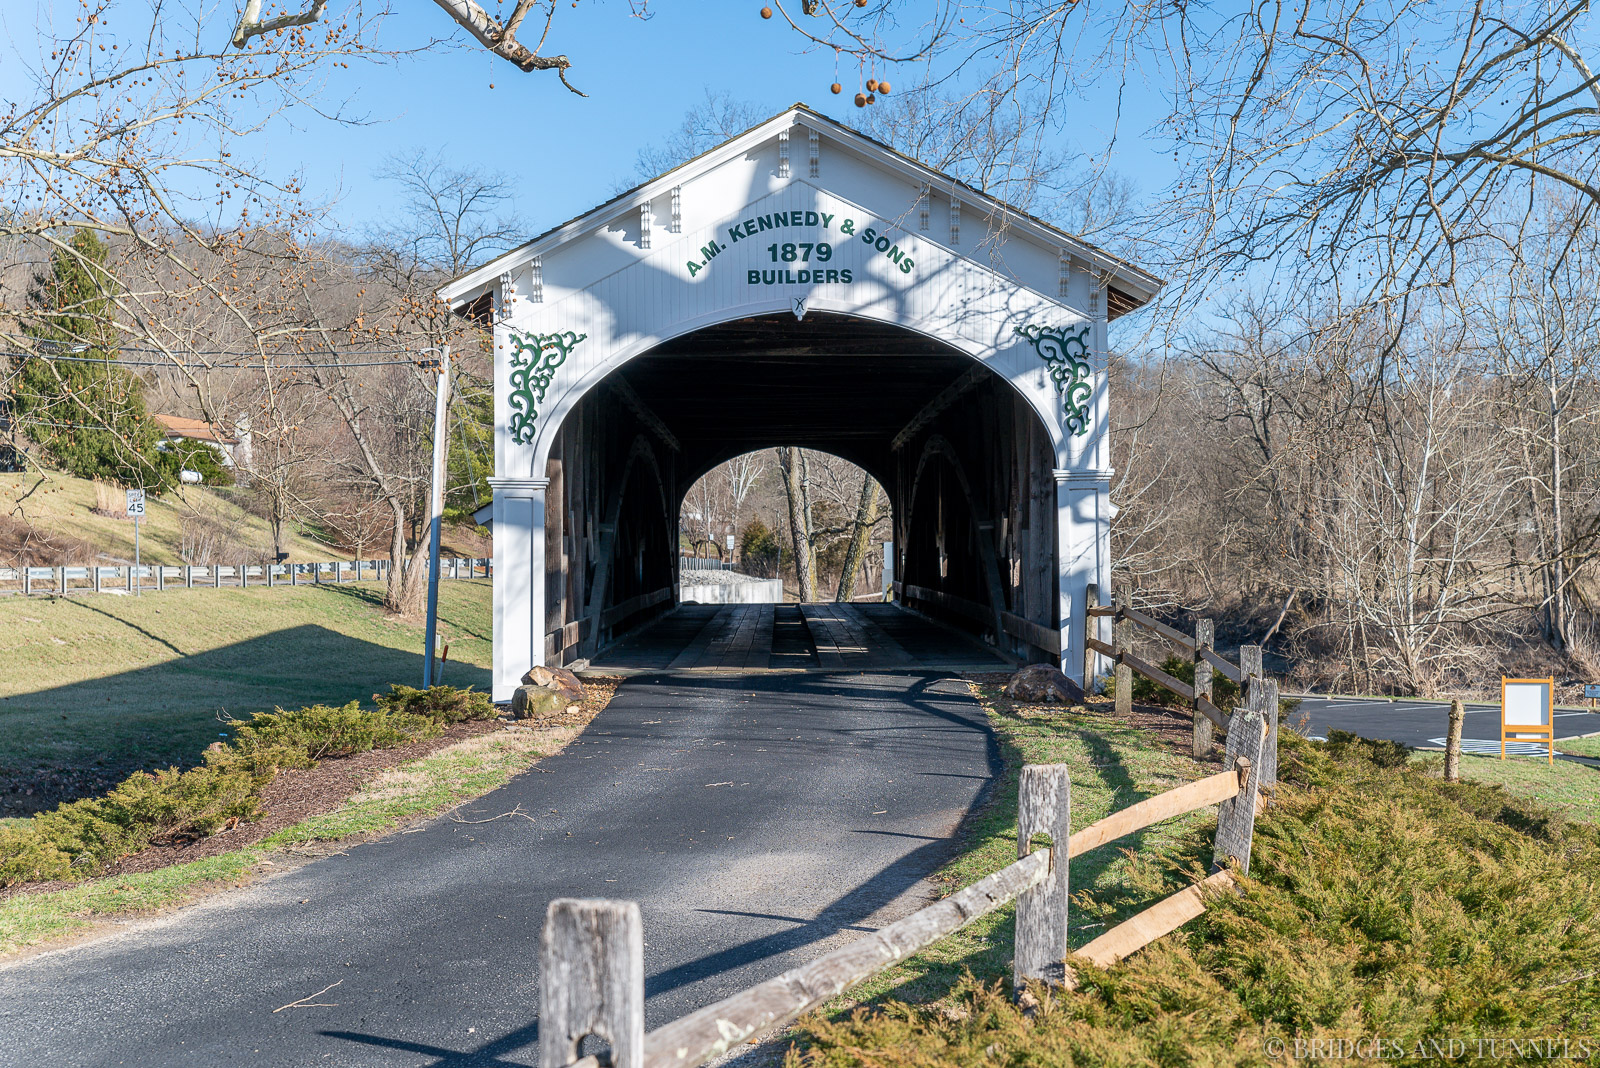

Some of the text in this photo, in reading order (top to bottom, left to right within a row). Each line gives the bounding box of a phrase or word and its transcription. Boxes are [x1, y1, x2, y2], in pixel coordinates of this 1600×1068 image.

[686, 211, 915, 277] A.M. KENNEDY & SONS
[767, 243, 833, 262] 1879
[747, 269, 853, 285] BUILDERS
[128, 503, 144, 513] 45
